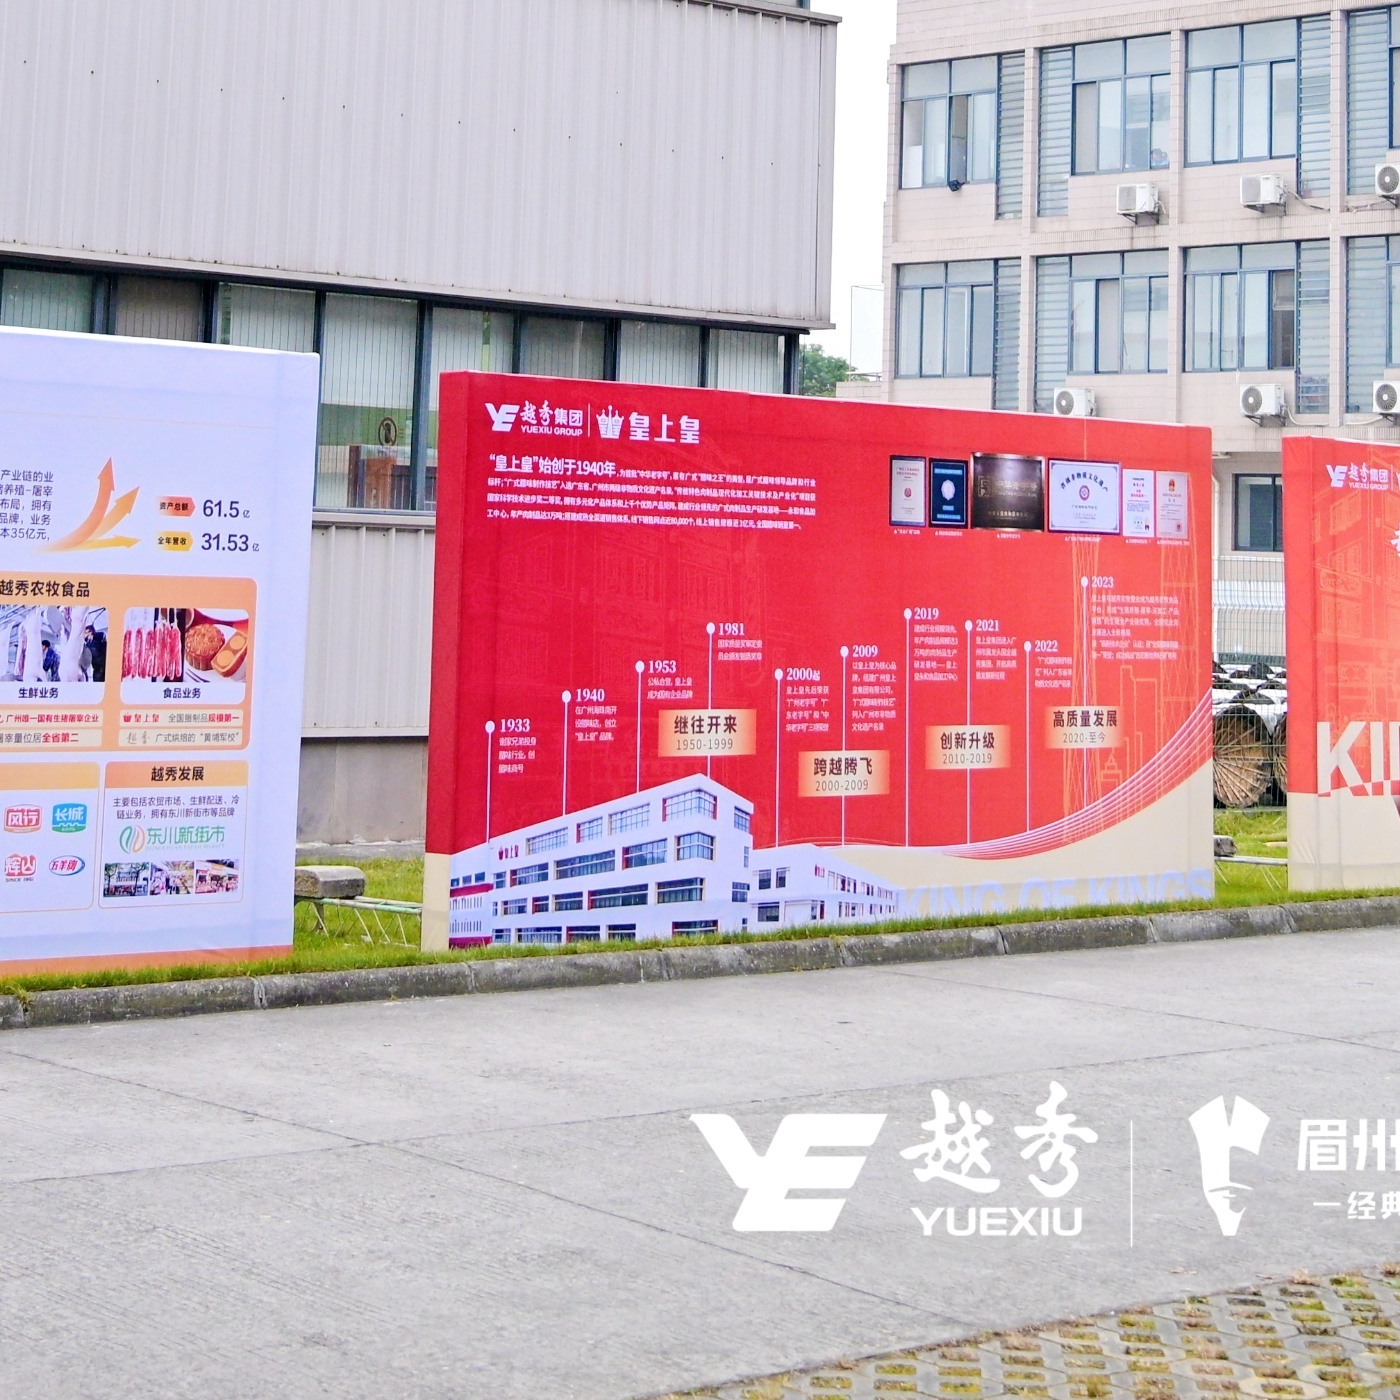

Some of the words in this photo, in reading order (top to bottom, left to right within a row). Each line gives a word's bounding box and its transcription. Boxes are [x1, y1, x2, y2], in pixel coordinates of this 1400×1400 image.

[520, 399, 584, 428] 越秀集团
[520, 425, 553, 435] YUEXIU
[554, 427, 583, 437] GROUP
[629, 411, 700, 445] 皇上皇
[1348, 461, 1389, 483] 越秀集团
[1349, 482, 1369, 490] YUEXIU
[159, 502, 189, 512] 资产总额
[158, 536, 187, 546] 全年营收
[0, 579, 91, 598] 越秀农牧食品
[1091, 576, 1115, 589] 2023
[914, 607, 940, 620] 2019
[718, 622, 746, 636] 1981
[976, 619, 999, 632] 2021
[852, 645, 879, 658] 2009
[1034, 640, 1059, 653] 2022
[648, 660, 678, 674] 1953
[786, 667, 821, 681] 2000起
[18, 687, 59, 699] 生鲜业务
[163, 687, 202, 699] 食品业务
[575, 688, 606, 702] 1940
[500, 718, 531, 733] 1933
[674, 714, 739, 735] 继往开来
[1053, 710, 1118, 728] 高质量发展
[676, 738, 734, 751] 1950-1999
[940, 732, 995, 750] 创新升级
[1063, 732, 1106, 744] 2020-至今
[942, 752, 993, 765] 2010-2019
[814, 756, 873, 777] 跨越腾飞
[150, 766, 205, 782] 越秀发展
[815, 779, 870, 792] 2000-2009
[8, 811, 39, 827] 风行
[55, 806, 85, 822] 长城
[147, 825, 225, 845] 东川新街市
[1087, 867, 1212, 905] KINGS
